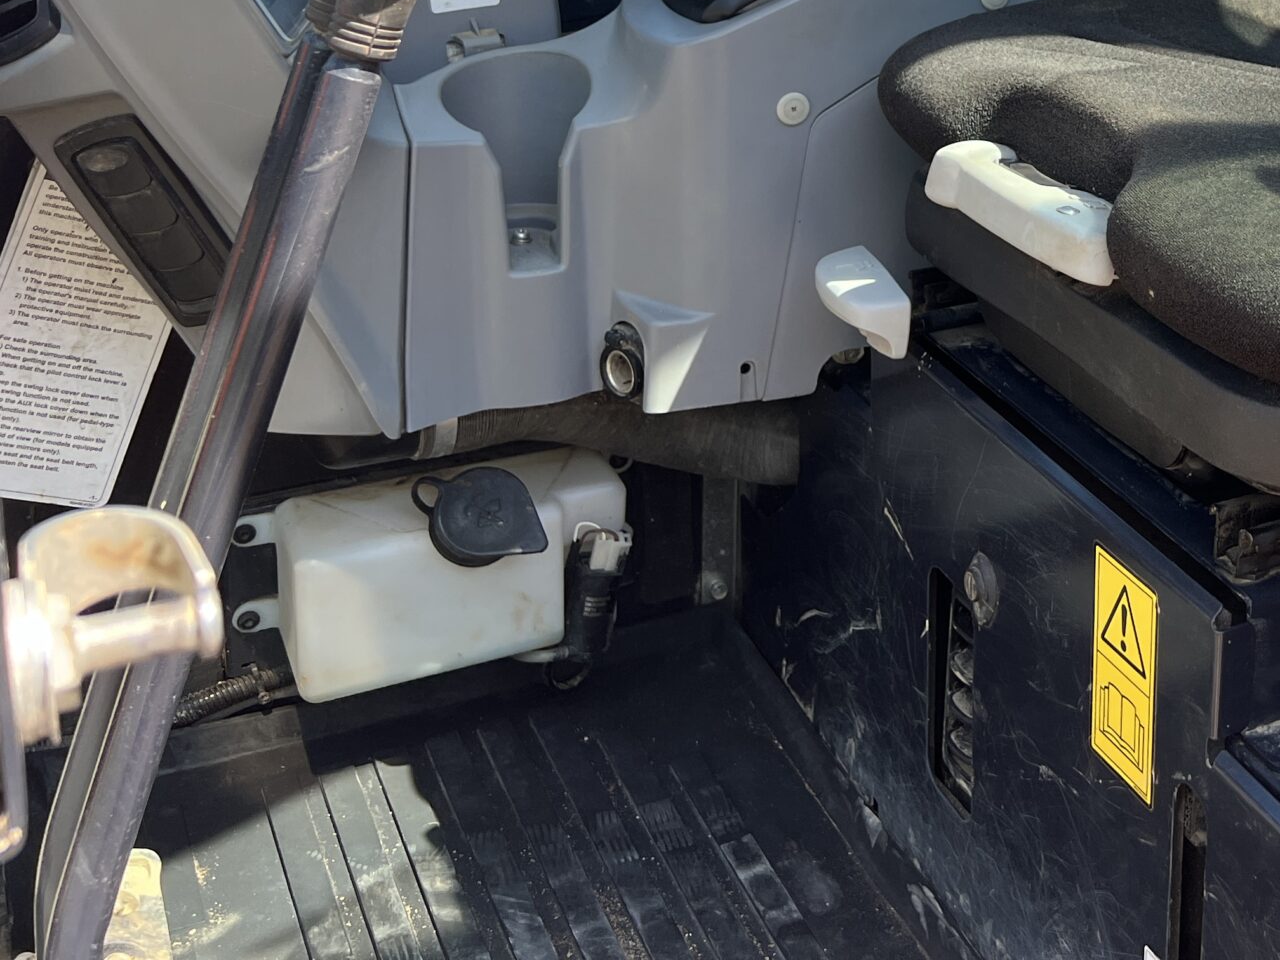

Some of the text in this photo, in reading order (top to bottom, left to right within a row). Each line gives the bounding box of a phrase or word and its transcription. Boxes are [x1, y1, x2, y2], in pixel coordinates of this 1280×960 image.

[33, 225, 48, 234] Only
[50, 230, 82, 239] operators
[29, 233, 56, 244] training
[71, 241, 108, 253] instruction
[26, 243, 52, 252] operate
[66, 250, 108, 262] construction
[34, 253, 67, 263] operators
[68, 259, 85, 267] must
[86, 262, 113, 272] observe
[25, 268, 47, 276] Before
[48, 273, 72, 282] getting
[96, 282, 124, 291] machine
[44, 281, 73, 290] operator
[74, 286, 91, 294] must
[38, 289, 72, 299] operator's
[74, 294, 99, 304] manual
[19, 303, 92, 320] protective equipment.
[37, 297, 67, 306] operator
[103, 310, 141, 320] appropriate
[31, 314, 60, 323] operator
[79, 322, 99, 330] check
[112, 329, 153, 340] surrounding
[29, 340, 61, 349] operation
[1, 352, 21, 360] When
[22, 357, 46, 366] getting
[4, 344, 26, 352] Check
[39, 351, 81, 363] surrounding
[23, 384, 44, 392] swing
[22, 391, 51, 400] function
[70, 407, 88, 415] down
[79, 418, 114, 428] pedal-type
[13, 426, 41, 434] rearview
[43, 430, 64, 438] mirror
[46, 440, 71, 448] models
[71, 443, 103, 452] equipped
